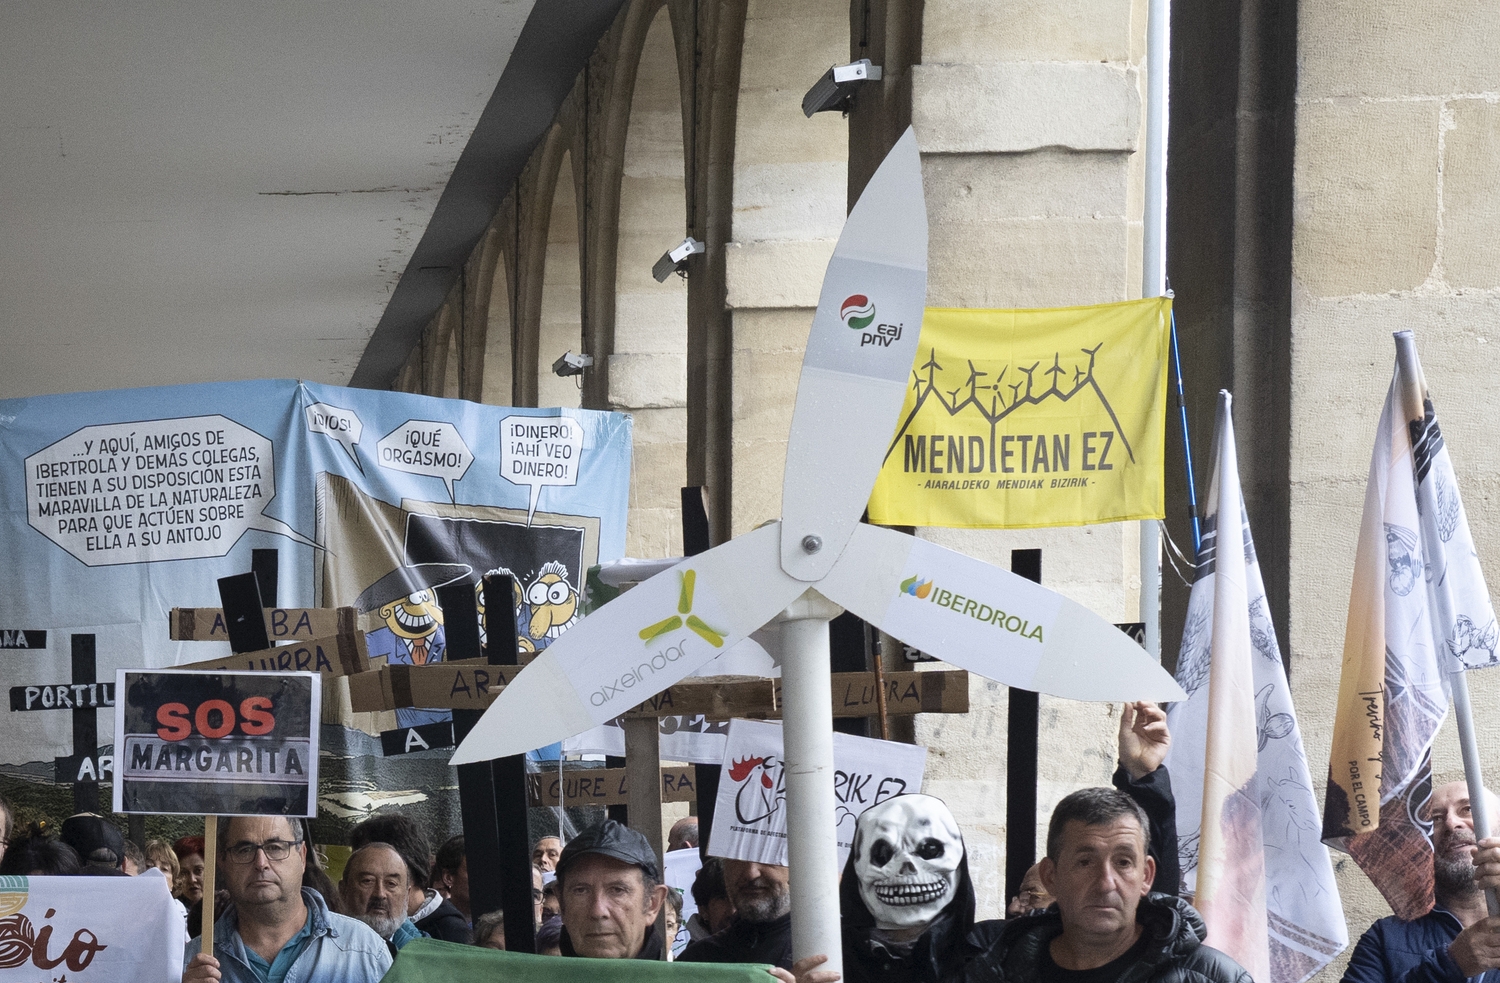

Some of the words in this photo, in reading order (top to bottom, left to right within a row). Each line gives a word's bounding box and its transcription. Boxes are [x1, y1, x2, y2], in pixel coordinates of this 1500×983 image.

[860, 332, 893, 348] pnv
[876, 323, 903, 341] eaj
[99, 432, 139, 456] AQUÍ,
[143, 432, 200, 451] AMIGOS
[205, 430, 225, 446] DE
[405, 428, 442, 448] ¡QUÉ
[509, 423, 573, 440] ¡DINERO!
[383, 446, 462, 468] ORGASMO!
[510, 439, 541, 458] ¡AHÍ
[545, 442, 572, 459] VEO
[903, 433, 1070, 474] MENDIETAN
[1082, 431, 1114, 471] EZ
[36, 458, 118, 479] IBERTROLA
[121, 456, 130, 472] Y
[136, 446, 188, 470] DEMÁS
[192, 447, 260, 466] COLEGAS,
[512, 462, 568, 479] DINERO!
[36, 480, 87, 498] TIENEN
[92, 477, 102, 494] A
[106, 476, 128, 492] SU
[132, 465, 224, 490] DISPOSICIÓN
[228, 464, 262, 482] ESTA
[924, 479, 990, 490] AIARALDEKO
[996, 478, 1043, 490] MENDIAK
[1050, 477, 1088, 489] BIZIRIK
[38, 496, 122, 518] MARAVILLA
[126, 494, 145, 510] DE
[149, 492, 168, 508] LA
[172, 484, 262, 507] NATURALEZA
[58, 515, 98, 535] PARA
[102, 514, 133, 533] QUE
[138, 507, 194, 529] ACTÚEN
[199, 504, 244, 522] SOBRE
[86, 533, 122, 552] ELLA
[126, 533, 137, 549] A
[141, 531, 162, 547] SU
[166, 525, 222, 544] ANTOJO
[930, 586, 1044, 643] IBERDROLA
[589, 637, 687, 708] aixeindar
[156, 696, 276, 741] SOS
[131, 743, 304, 776] MARGARITA
[1348, 760, 1359, 781] POR
[1352, 781, 1362, 793] EL
[1354, 793, 1371, 827] CAMPO
